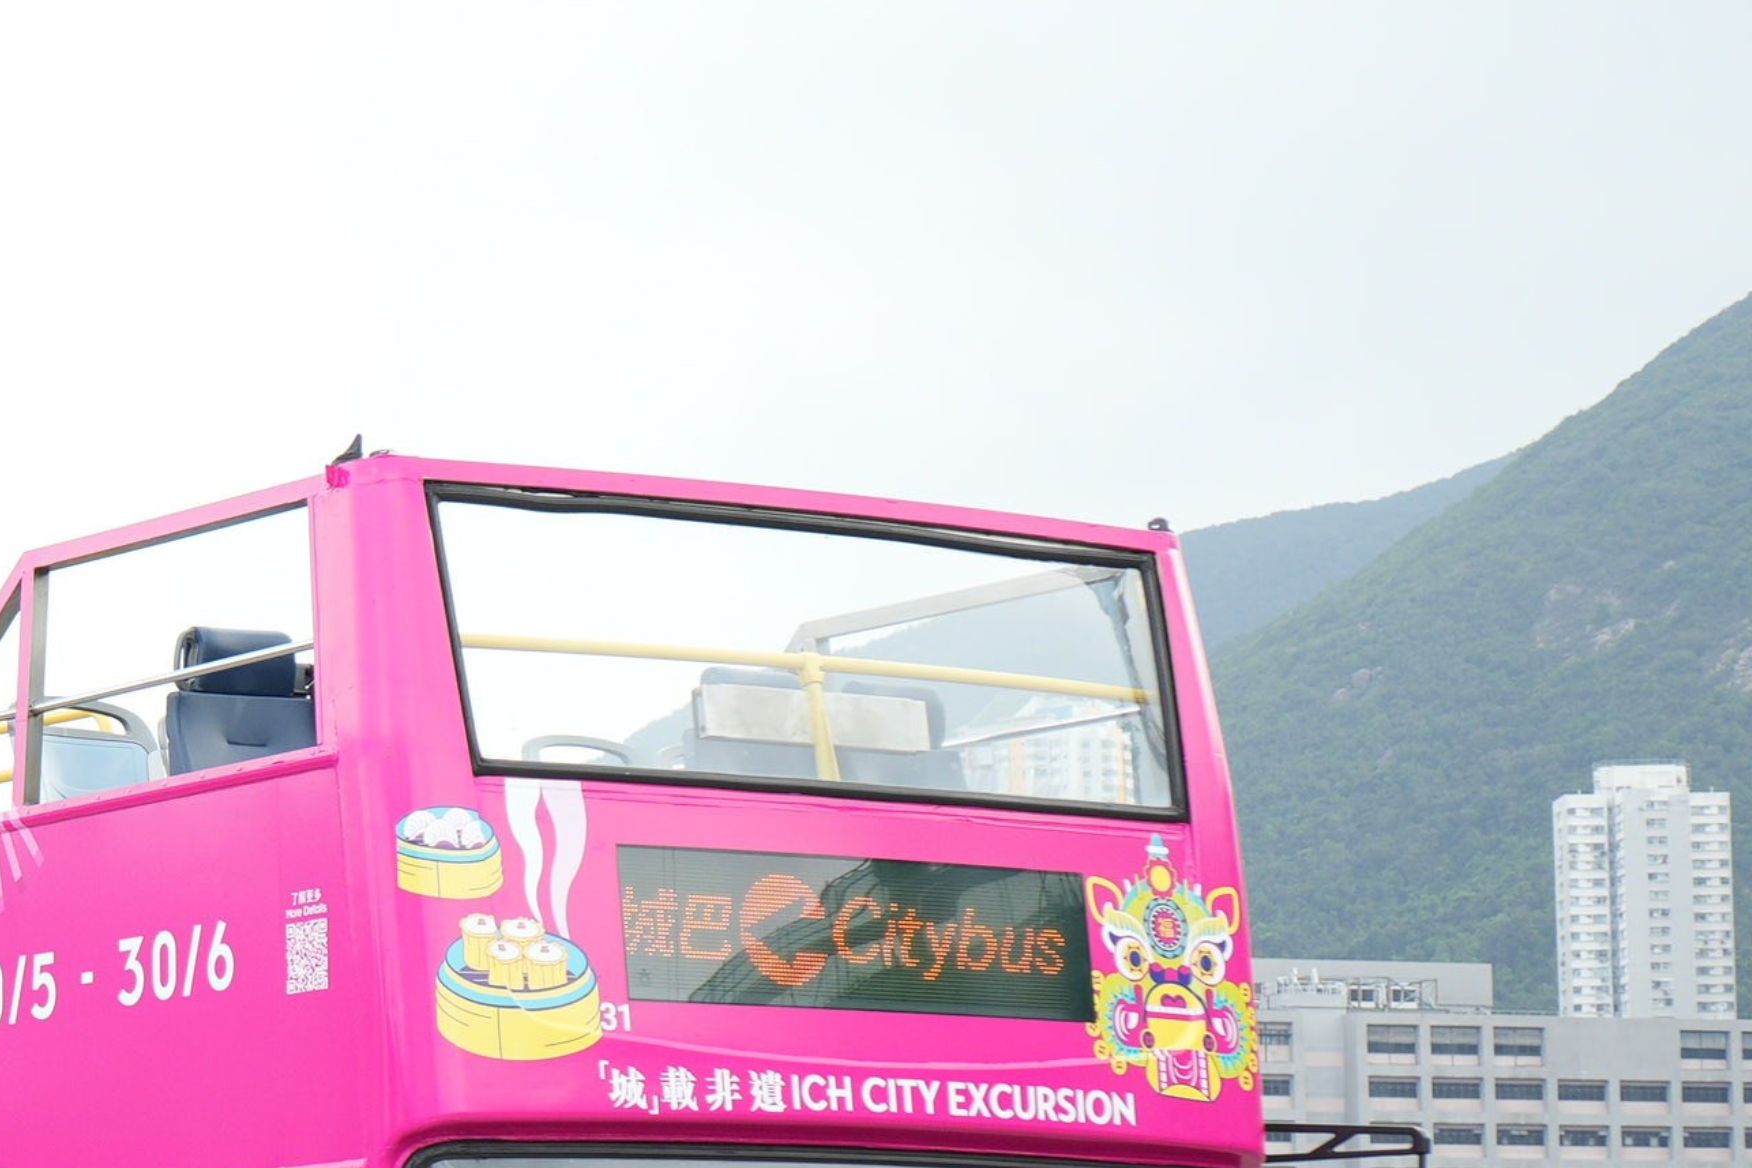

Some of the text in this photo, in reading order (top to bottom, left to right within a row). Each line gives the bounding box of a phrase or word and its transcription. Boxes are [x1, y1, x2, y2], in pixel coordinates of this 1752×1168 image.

[117, 919, 235, 1007] 30/6
[832, 896, 1066, 983] Citybus
[600, 1002, 632, 1032] 31
[791, 1074, 1137, 1128] ICH CITY EXCURSION
